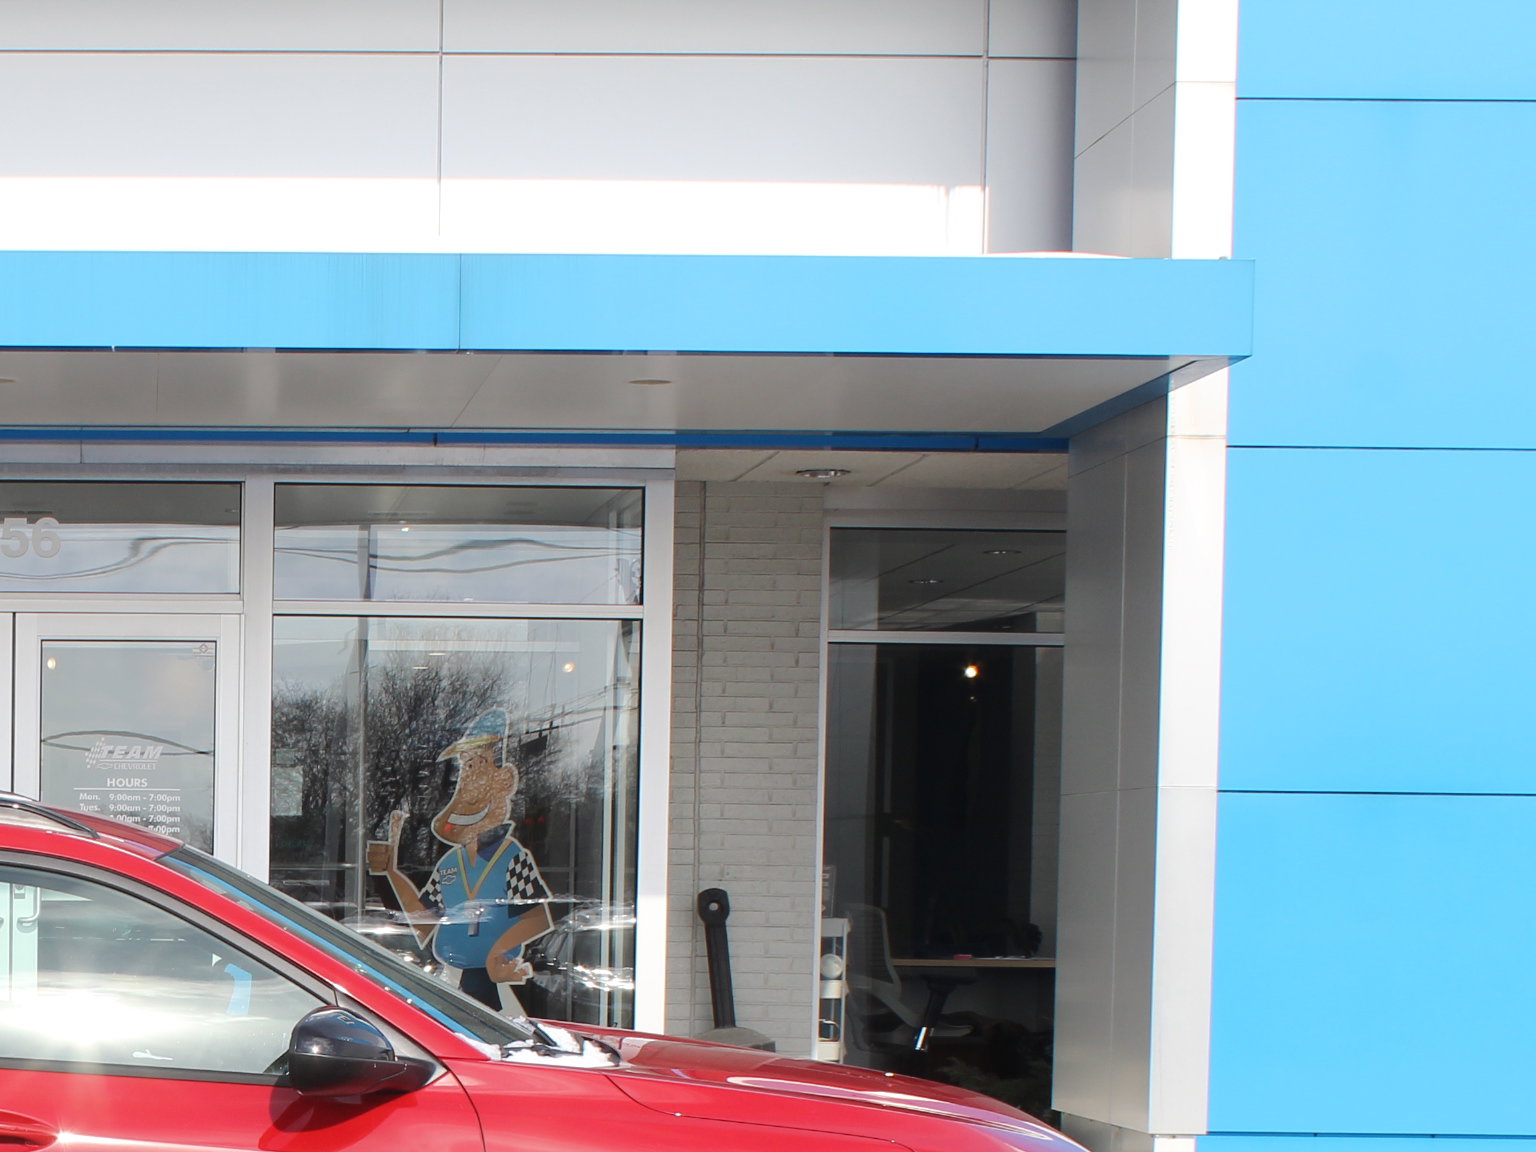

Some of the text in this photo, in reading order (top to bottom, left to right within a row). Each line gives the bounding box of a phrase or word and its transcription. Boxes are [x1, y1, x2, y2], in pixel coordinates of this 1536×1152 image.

[100, 745, 164, 759] TEAM
[106, 778, 148, 787] HOURS
[79, 793, 101, 801] Mon.
[109, 793, 141, 801] 9:00am
[149, 793, 181, 802] 7:00pm
[79, 803, 101, 812] Tues.
[109, 804, 141, 812] 9:00am
[149, 804, 181, 813] 7:00pm
[149, 815, 181, 824] 7:00pm
[440, 867, 457, 876] TEAM
